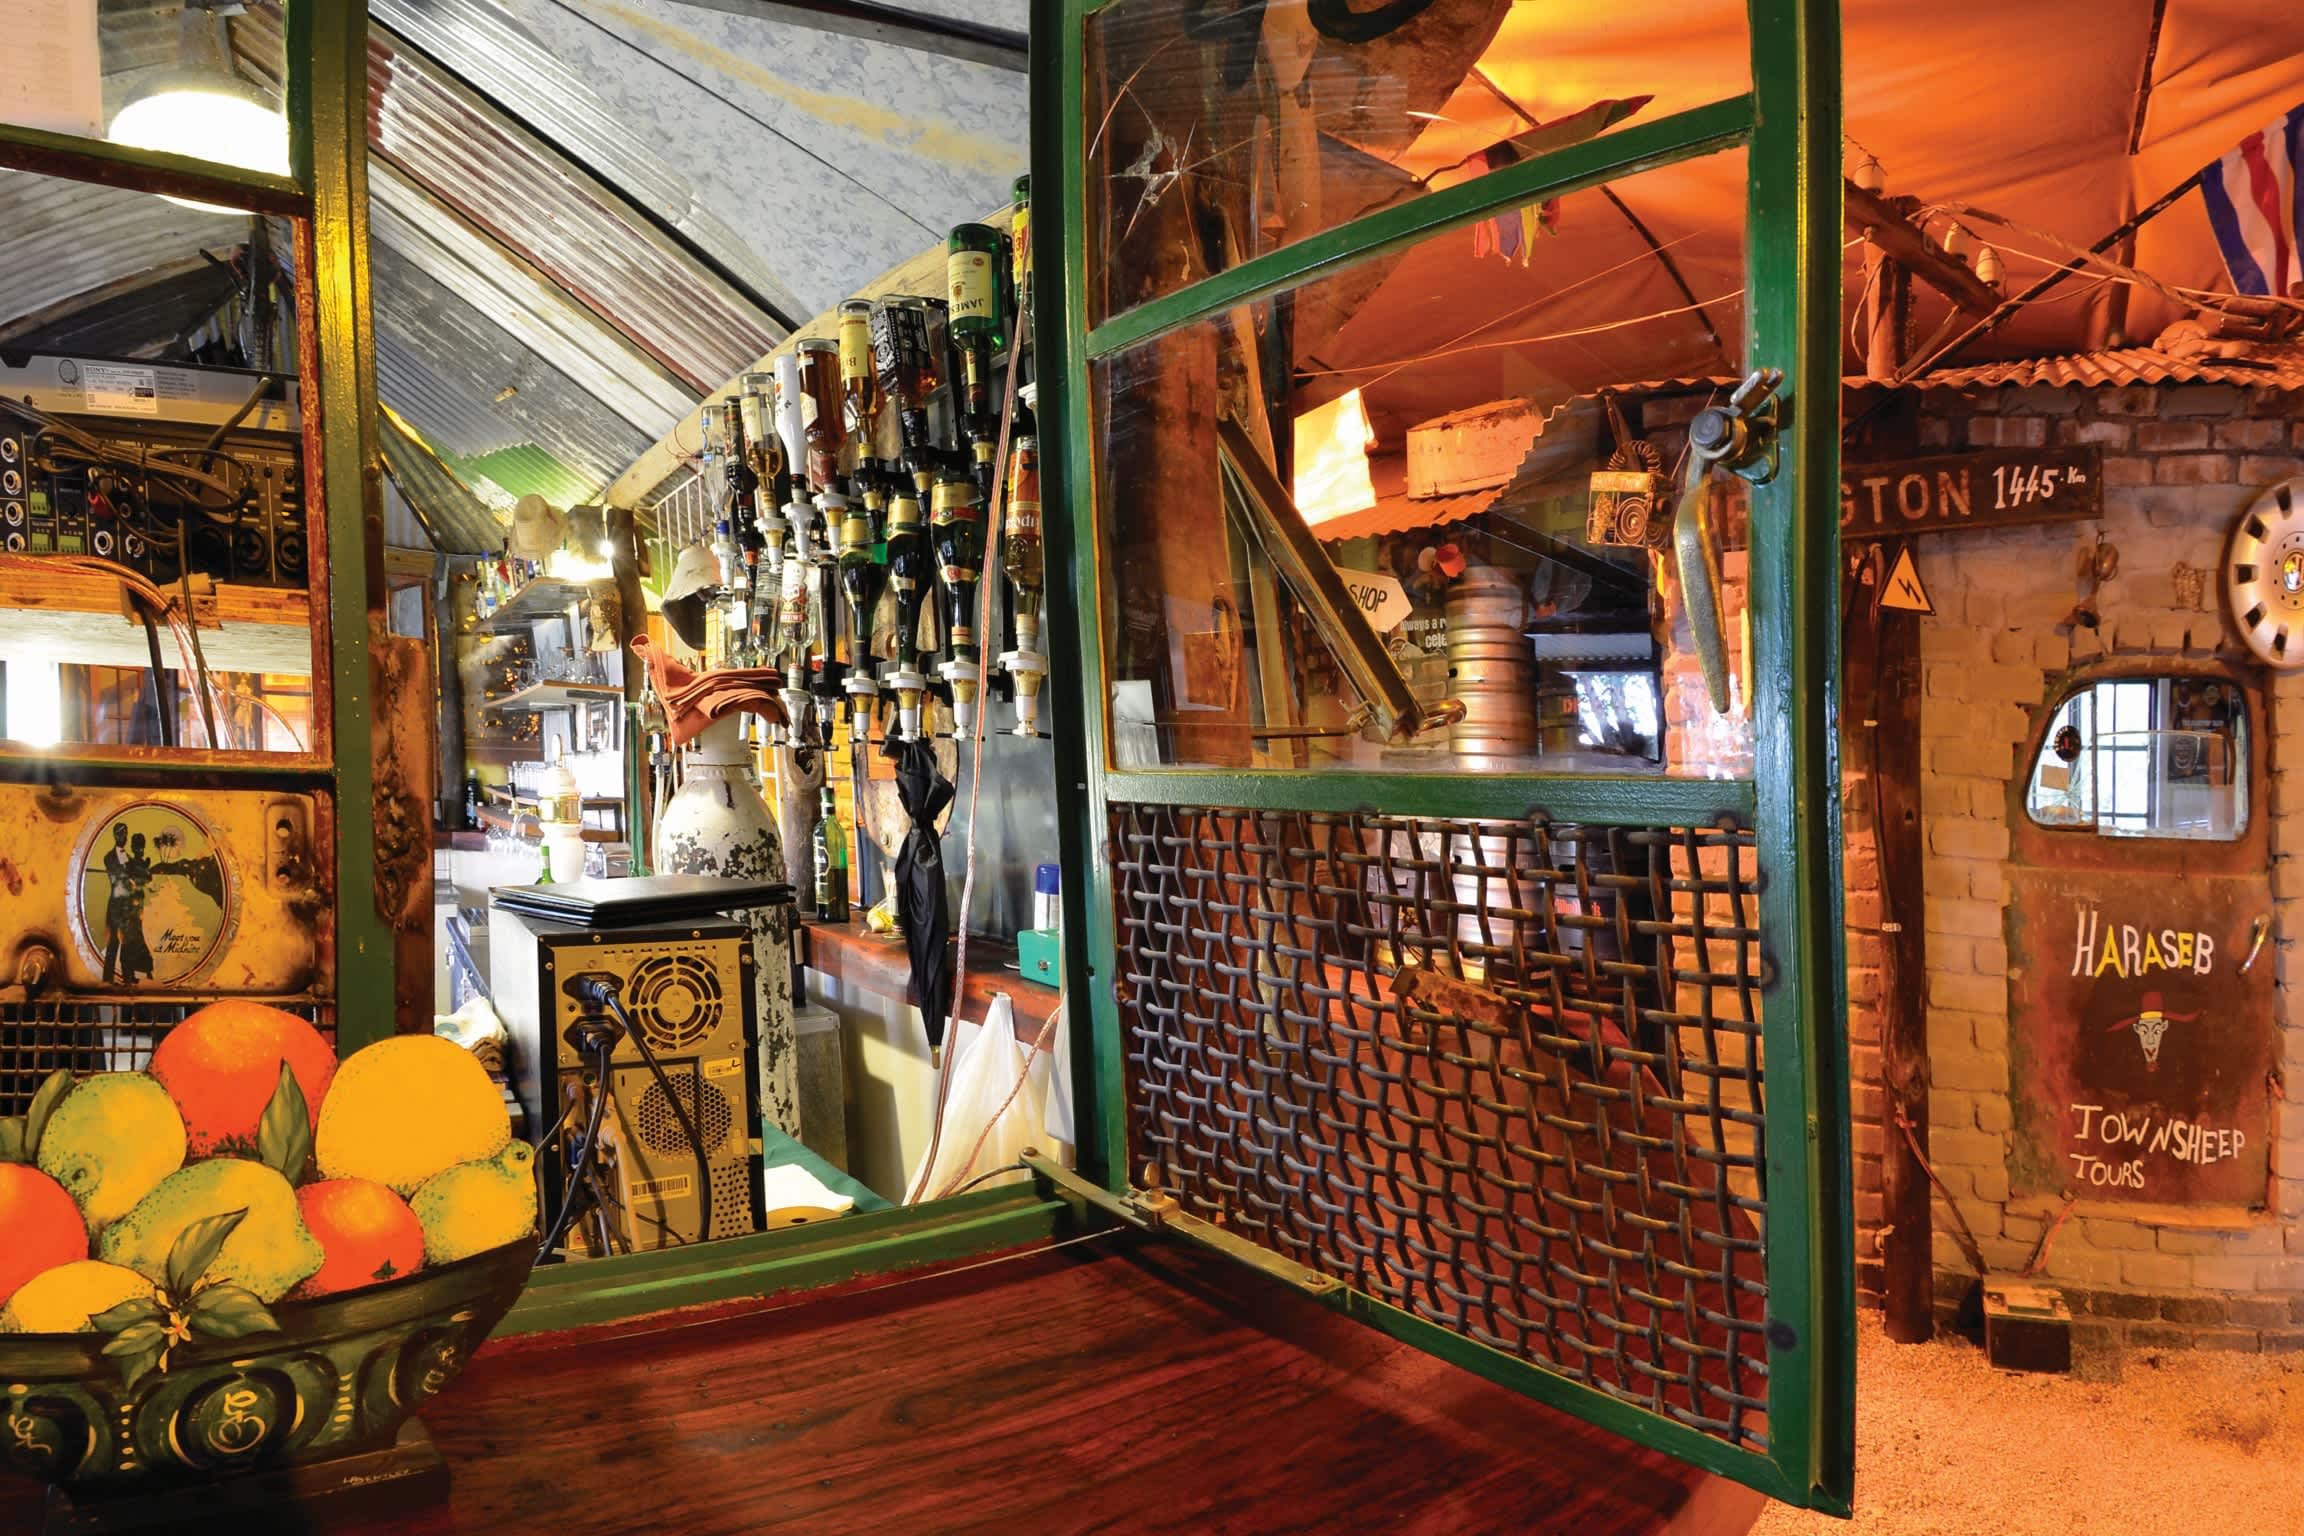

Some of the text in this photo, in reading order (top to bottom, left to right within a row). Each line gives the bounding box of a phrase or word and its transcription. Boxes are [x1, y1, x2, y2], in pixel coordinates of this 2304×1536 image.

[1349, 583, 1388, 613] SHOP
[2072, 909, 2214, 978] HARASEB
[2071, 1103, 2246, 1165] TOWNSHEEP
[2069, 1153, 2146, 1188] TOURS
